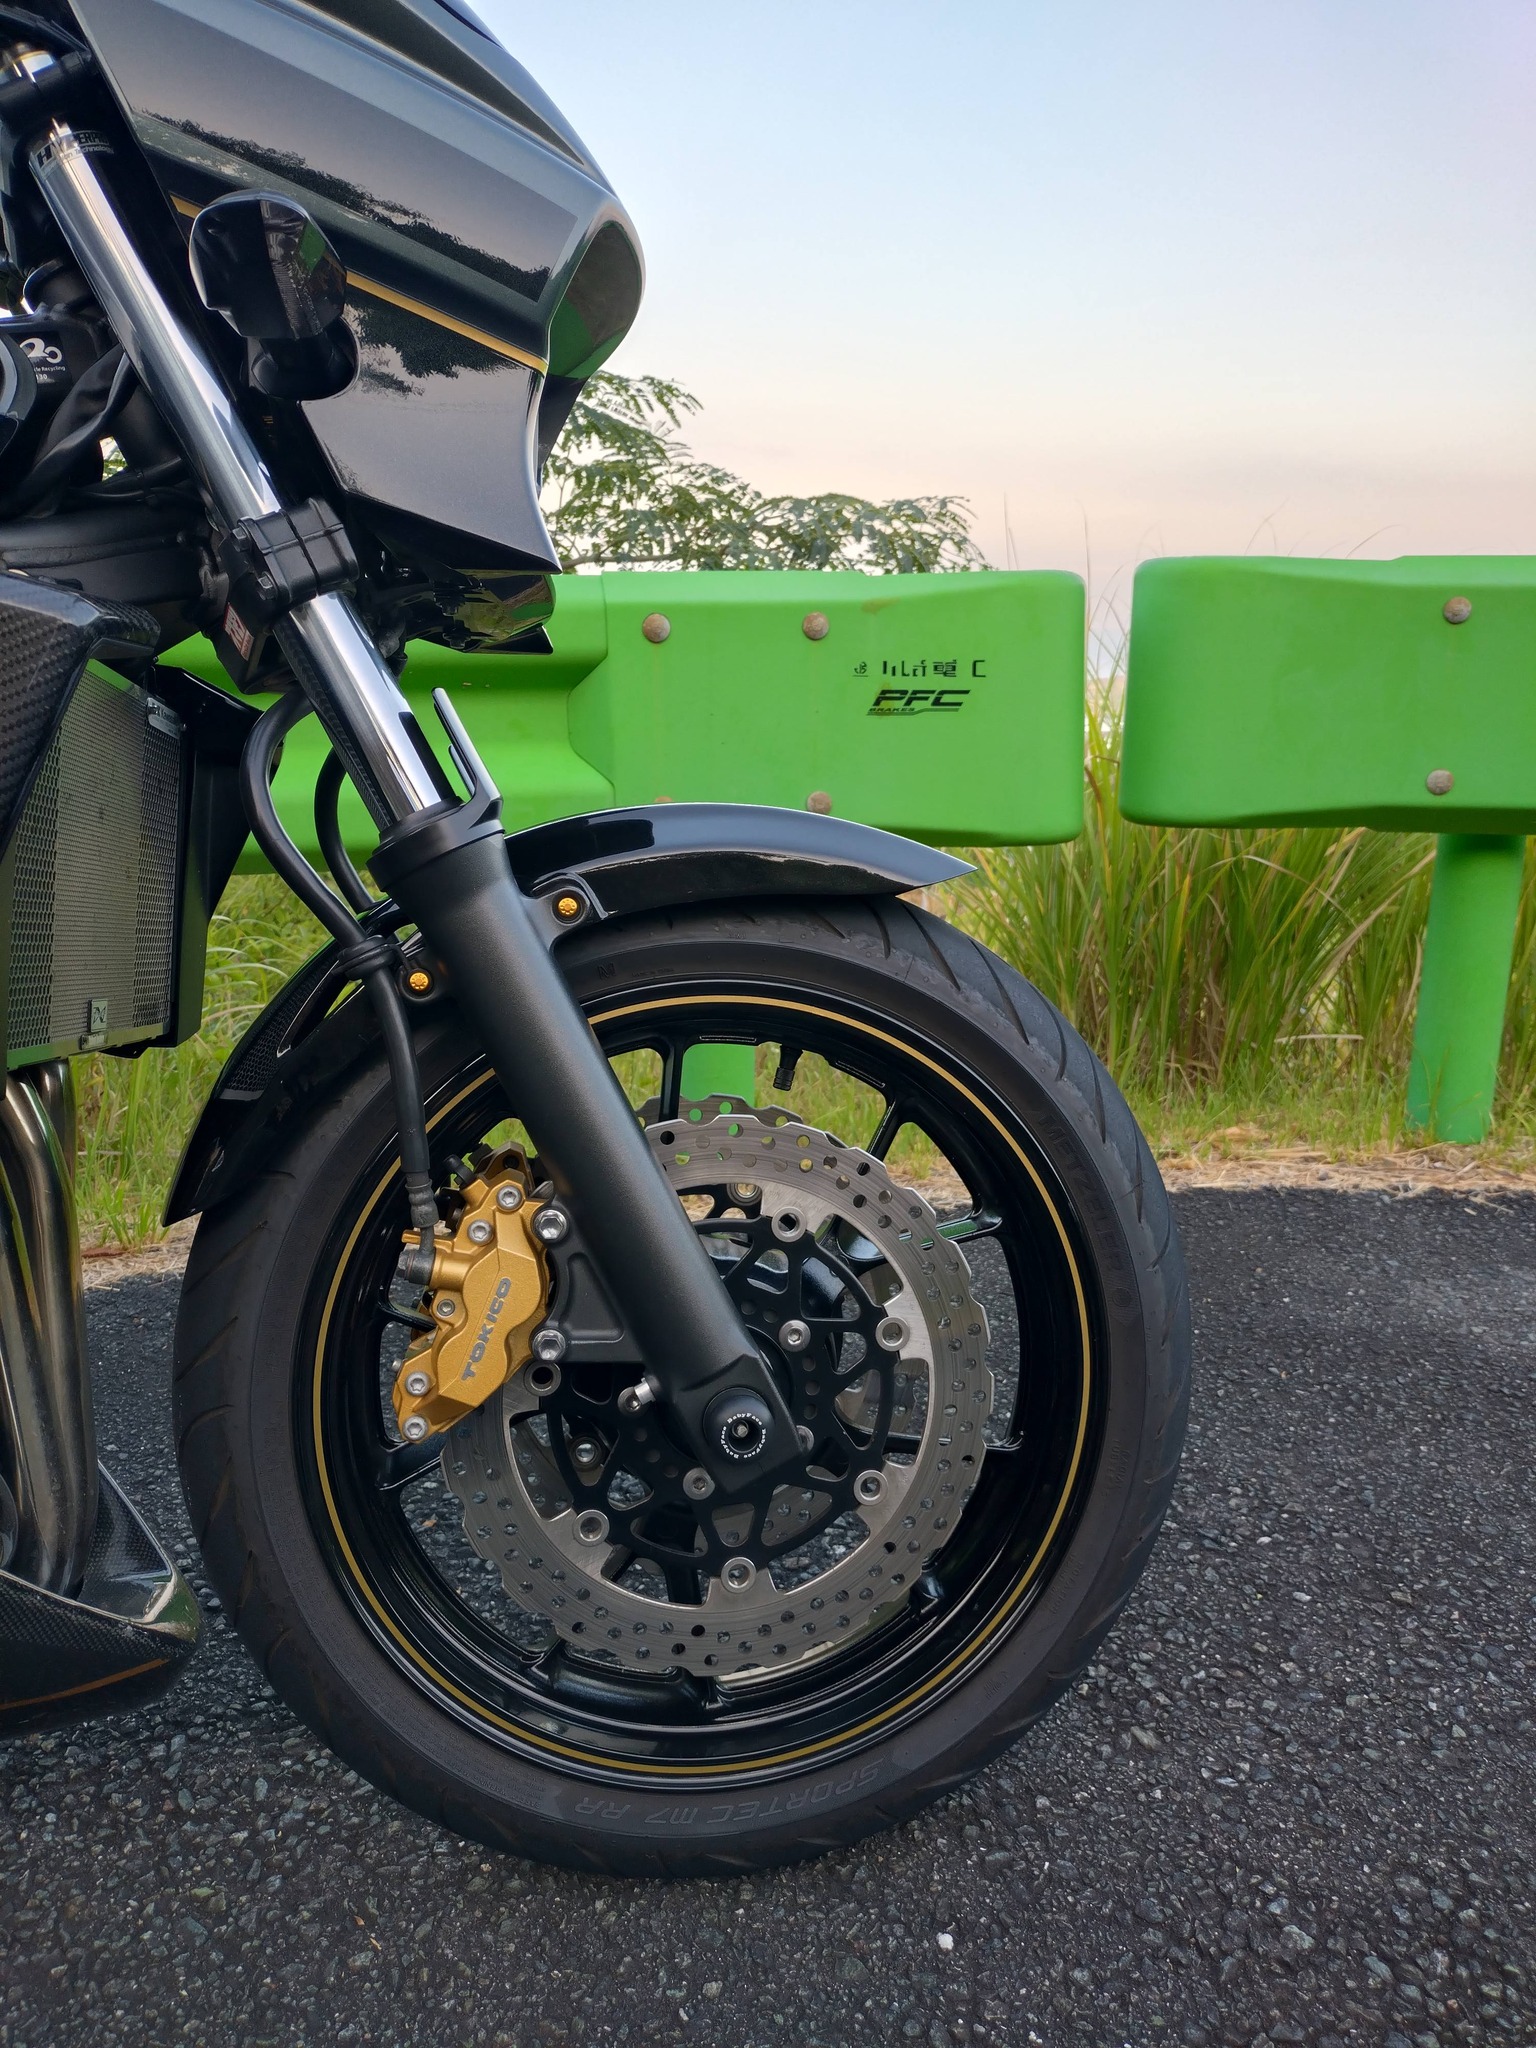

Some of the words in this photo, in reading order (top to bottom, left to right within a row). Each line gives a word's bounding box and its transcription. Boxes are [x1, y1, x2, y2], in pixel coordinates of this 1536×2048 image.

[872, 689, 971, 707] PFC
[461, 1277, 512, 1381] TOKICO
[727, 1412, 762, 1426] BabyFace
[706, 1757, 885, 1823] SPORTEC
[574, 1796, 631, 1819] RR
[644, 1807, 699, 1824] M7
